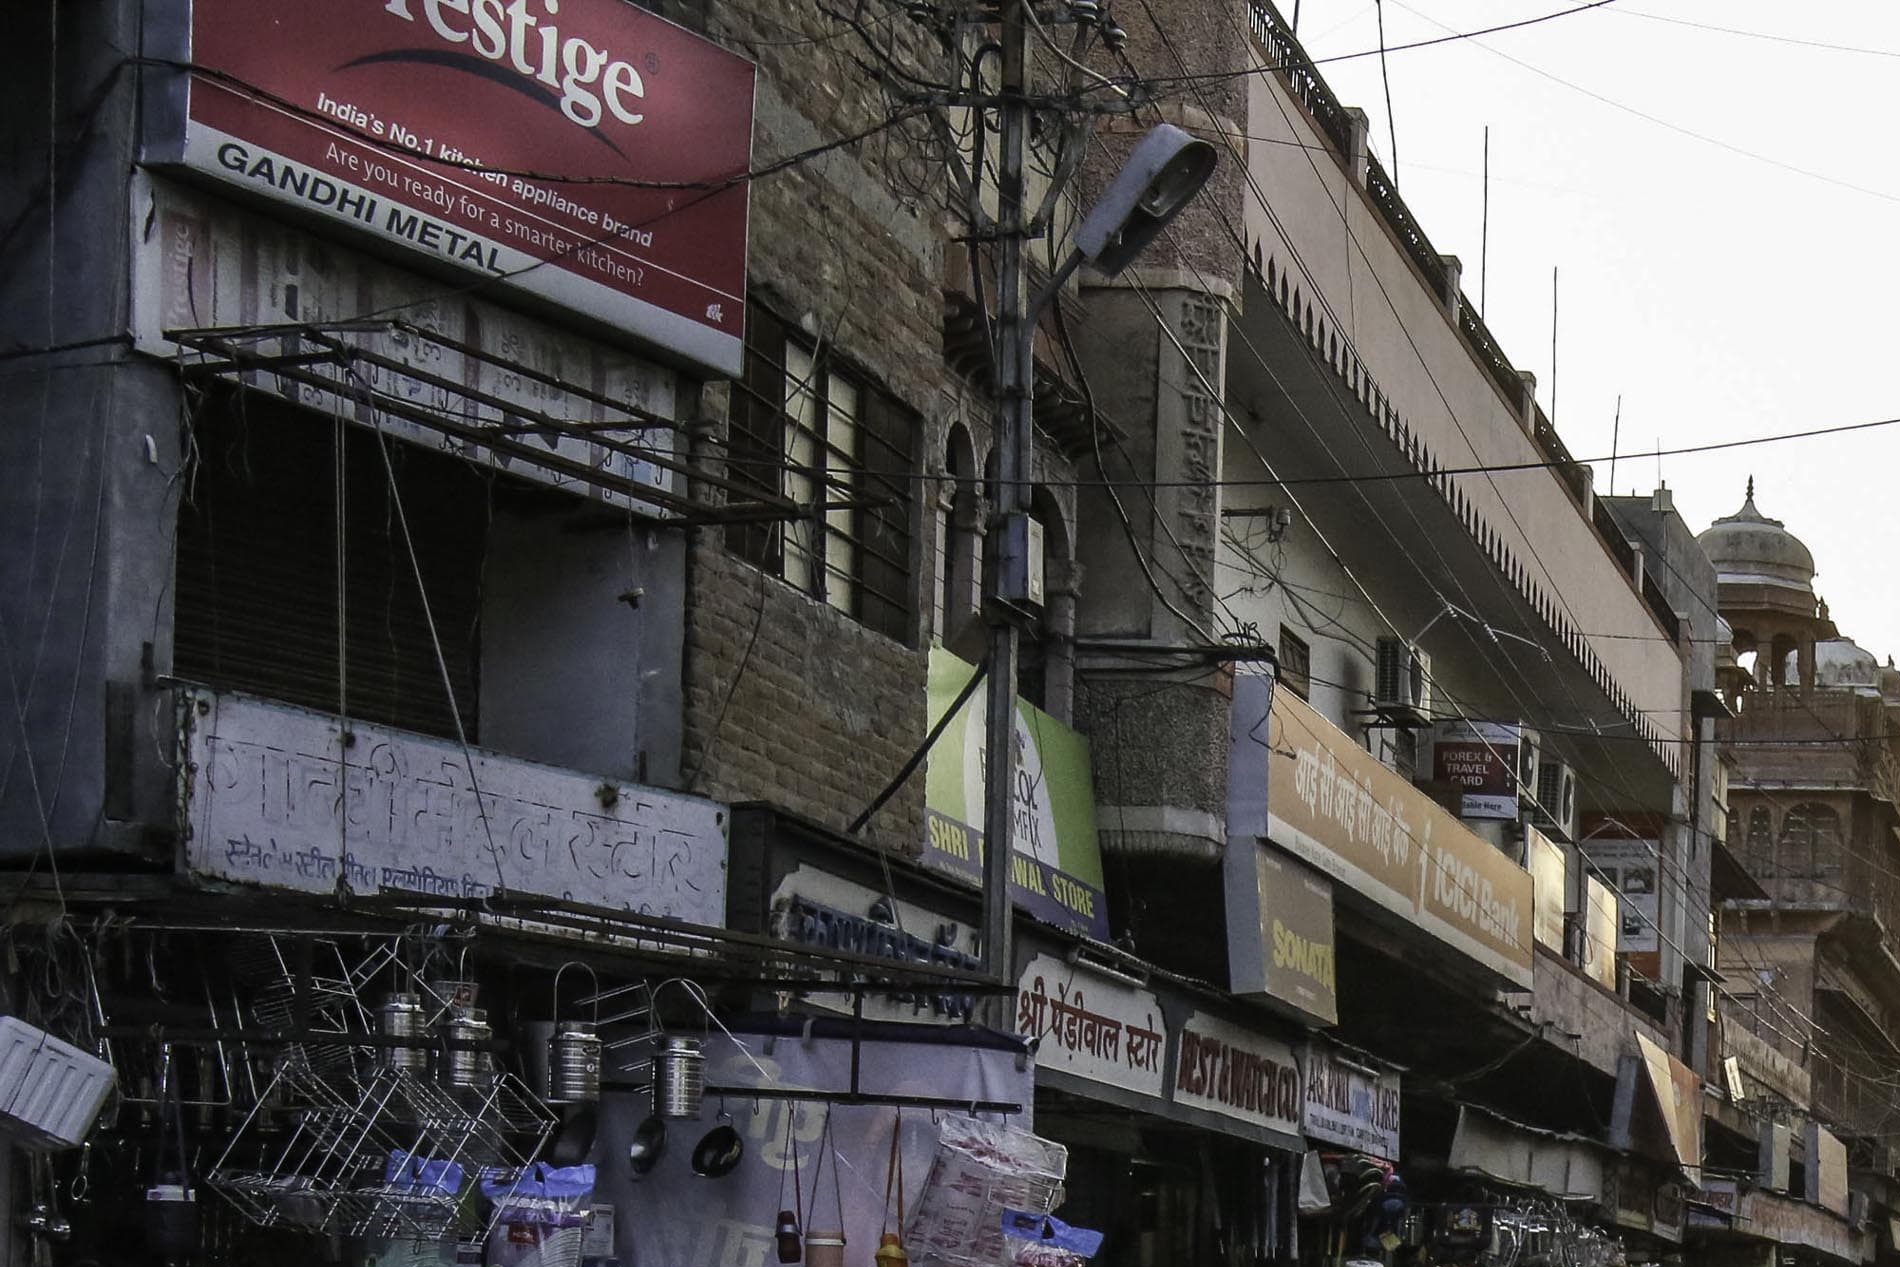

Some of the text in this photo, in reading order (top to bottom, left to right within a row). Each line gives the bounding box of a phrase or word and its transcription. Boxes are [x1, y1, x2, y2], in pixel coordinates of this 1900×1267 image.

[217, 142, 507, 276] GANDHI METAL
[316, 92, 654, 249] India's No.1 kitchen appliance brand
[325, 140, 645, 287] Are you ready for a smarter kitchen?
[1443, 751, 1493, 763] FOREX &
[1446, 763, 1490, 775] TRAVEL
[928, 815, 969, 861] SHRI
[1053, 875, 1095, 918] STORE
[1434, 852, 1519, 950] ICICI Bank
[1018, 976, 1048, 1037] श्री
[1126, 1013, 1163, 1074] स्टोर
